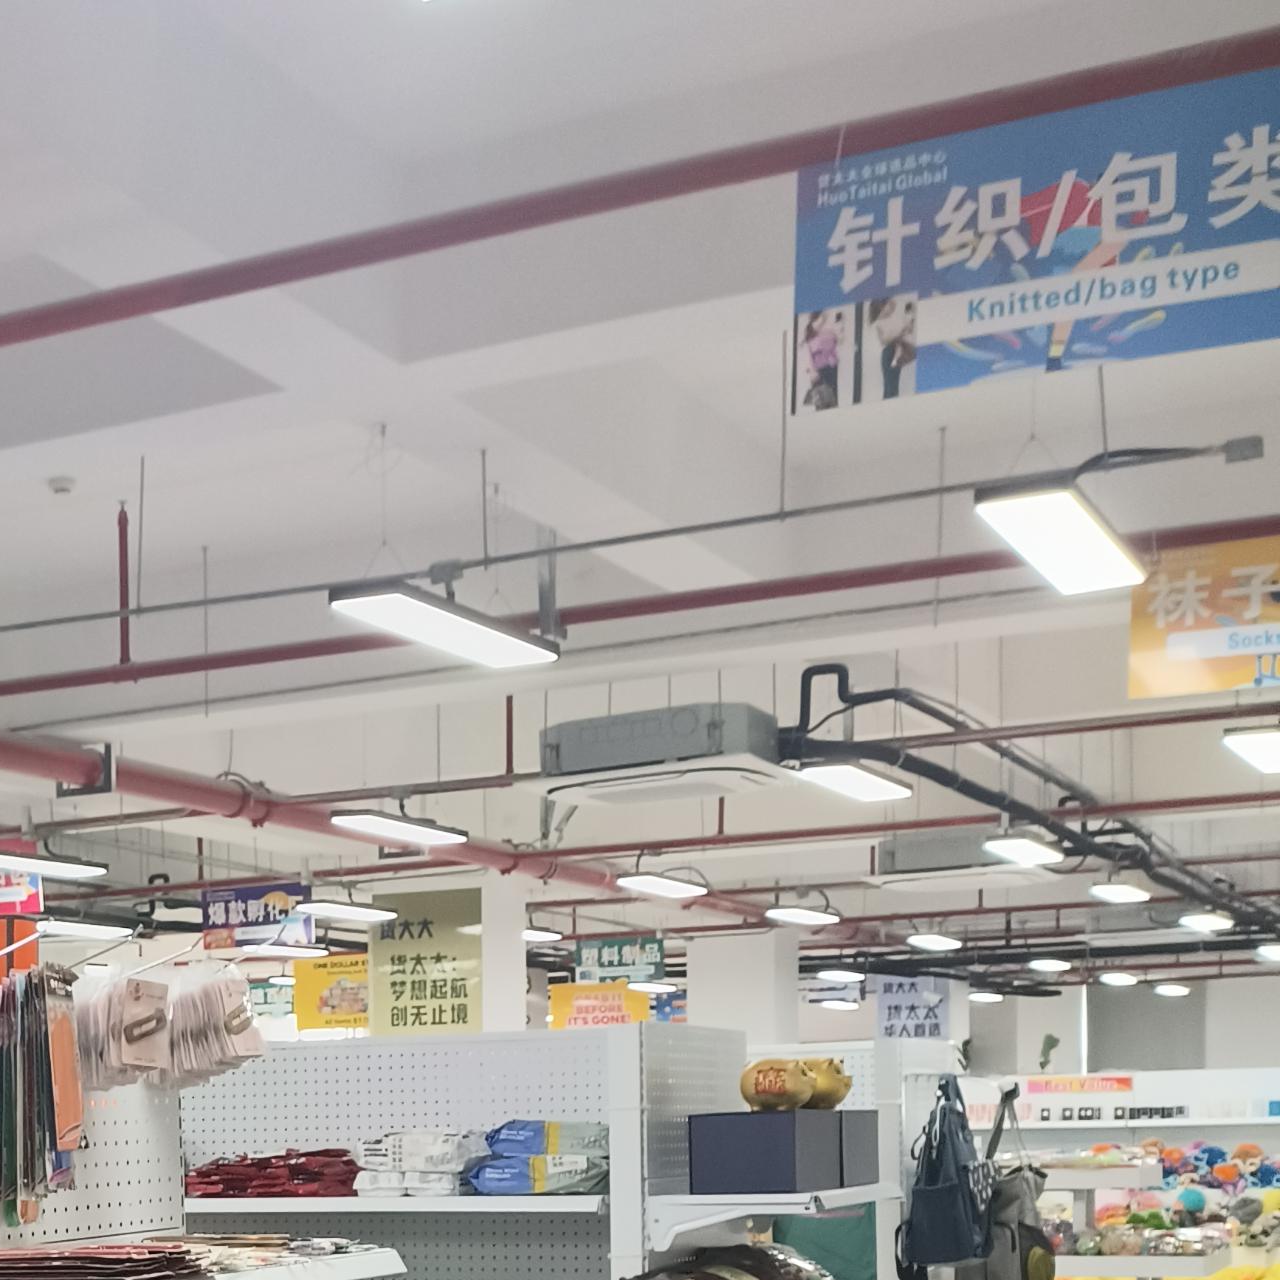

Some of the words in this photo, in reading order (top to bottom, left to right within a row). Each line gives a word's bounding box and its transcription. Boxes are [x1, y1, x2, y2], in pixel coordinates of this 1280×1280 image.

[895, 165, 948, 191] Global
[968, 273, 1157, 322] Knitted/bag
[1169, 260, 1241, 291] type
[1147, 563, 1280, 629] 袜子
[330, 960, 359, 969] DOLLAR
[389, 977, 468, 1001] 梦想起航
[390, 1003, 468, 1027] 创无止境
[568, 1016, 589, 1026] IT'S
[591, 1013, 632, 1025] GONE!
[576, 1004, 623, 1015] BEFORE
